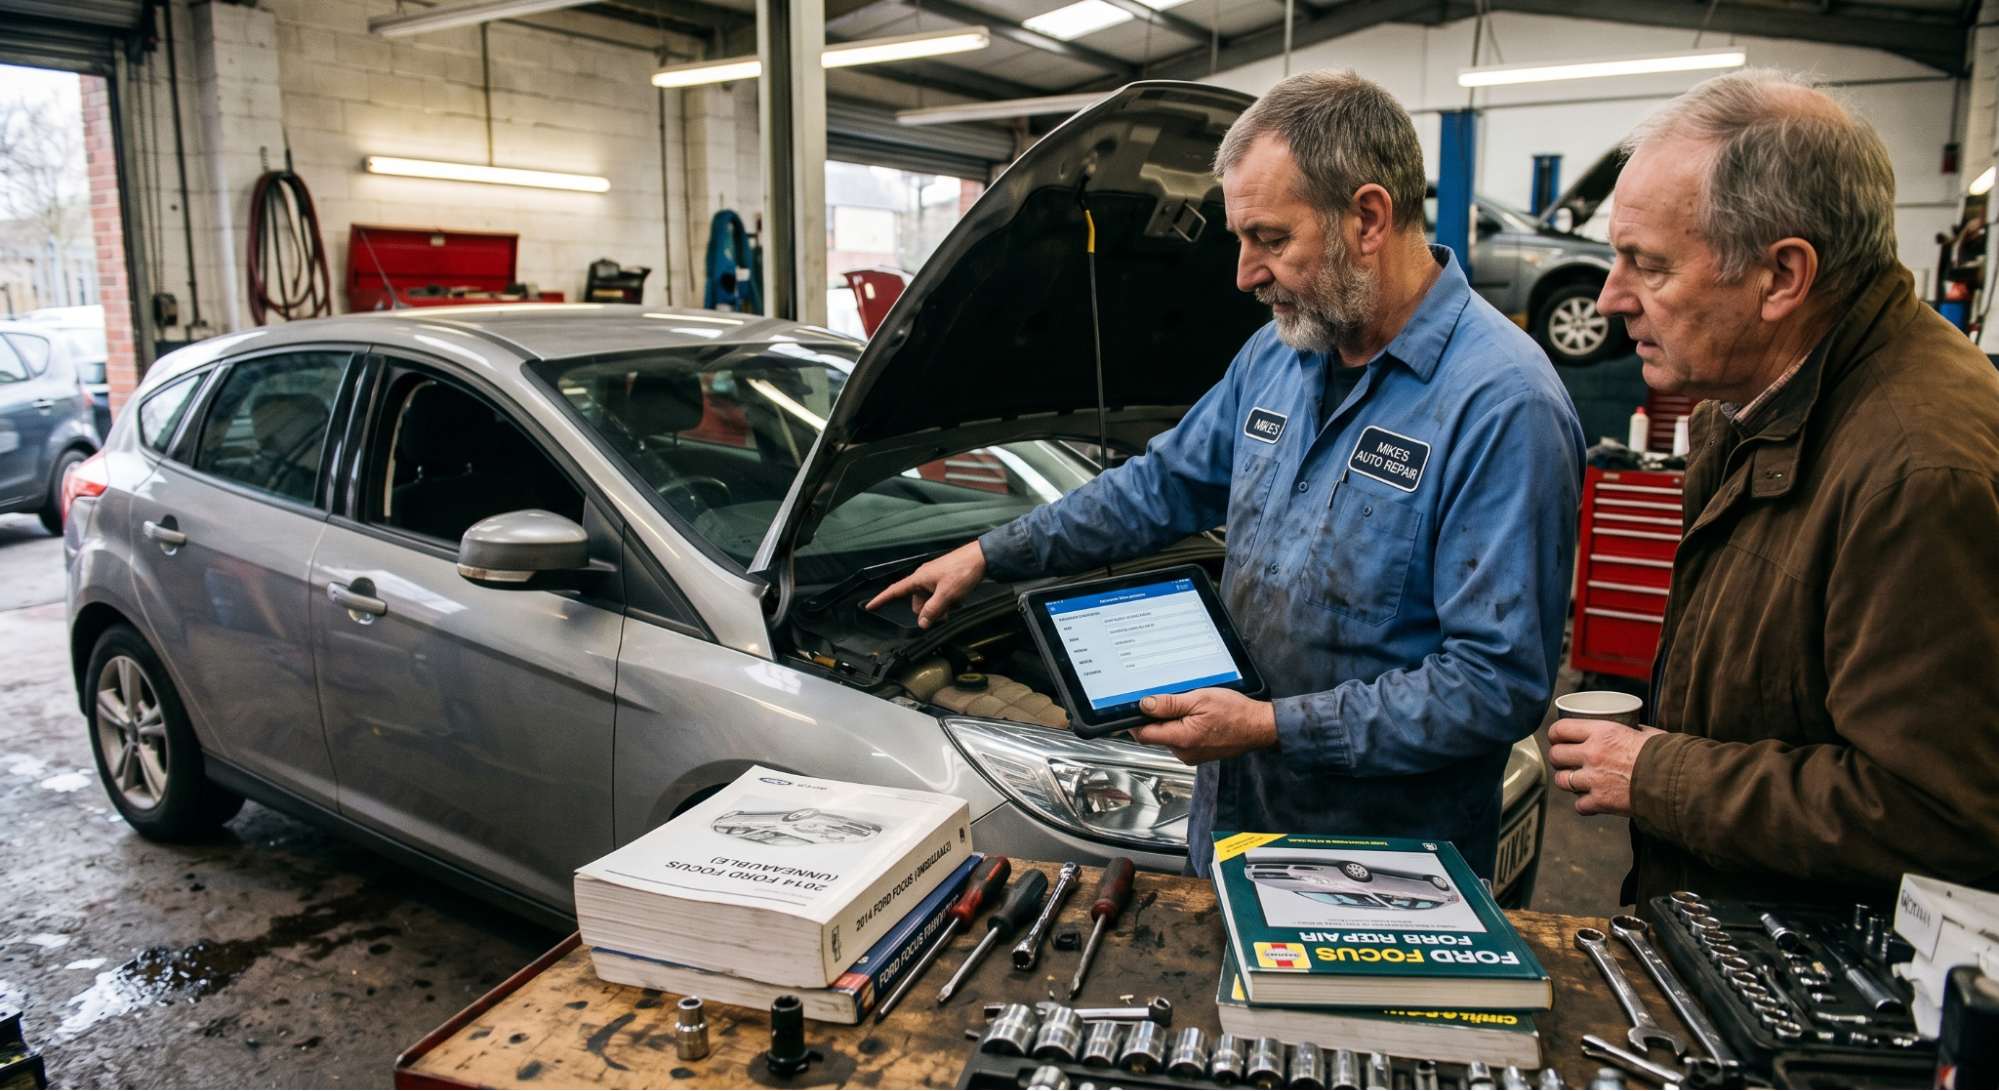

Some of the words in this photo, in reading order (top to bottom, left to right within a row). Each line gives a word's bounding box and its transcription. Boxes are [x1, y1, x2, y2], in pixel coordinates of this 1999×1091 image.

[1253, 418, 1281, 436] MIKES
[1376, 441, 1411, 462] MIKES
[1355, 449, 1383, 468] AUTO
[1383, 460, 1418, 481] REPAIR
[665, 860, 727, 877] FOCUS
[728, 870, 780, 884] FORD
[782, 878, 828, 892] 2014
[855, 907, 873, 932] 2014
[873, 893, 892, 917] FORD
[892, 873, 914, 901] FOCUS
[879, 957, 900, 989] FORD
[900, 932, 924, 966] FOCUS
[1314, 946, 1425, 963] FOCUS
[1429, 949, 1521, 965] FORD
